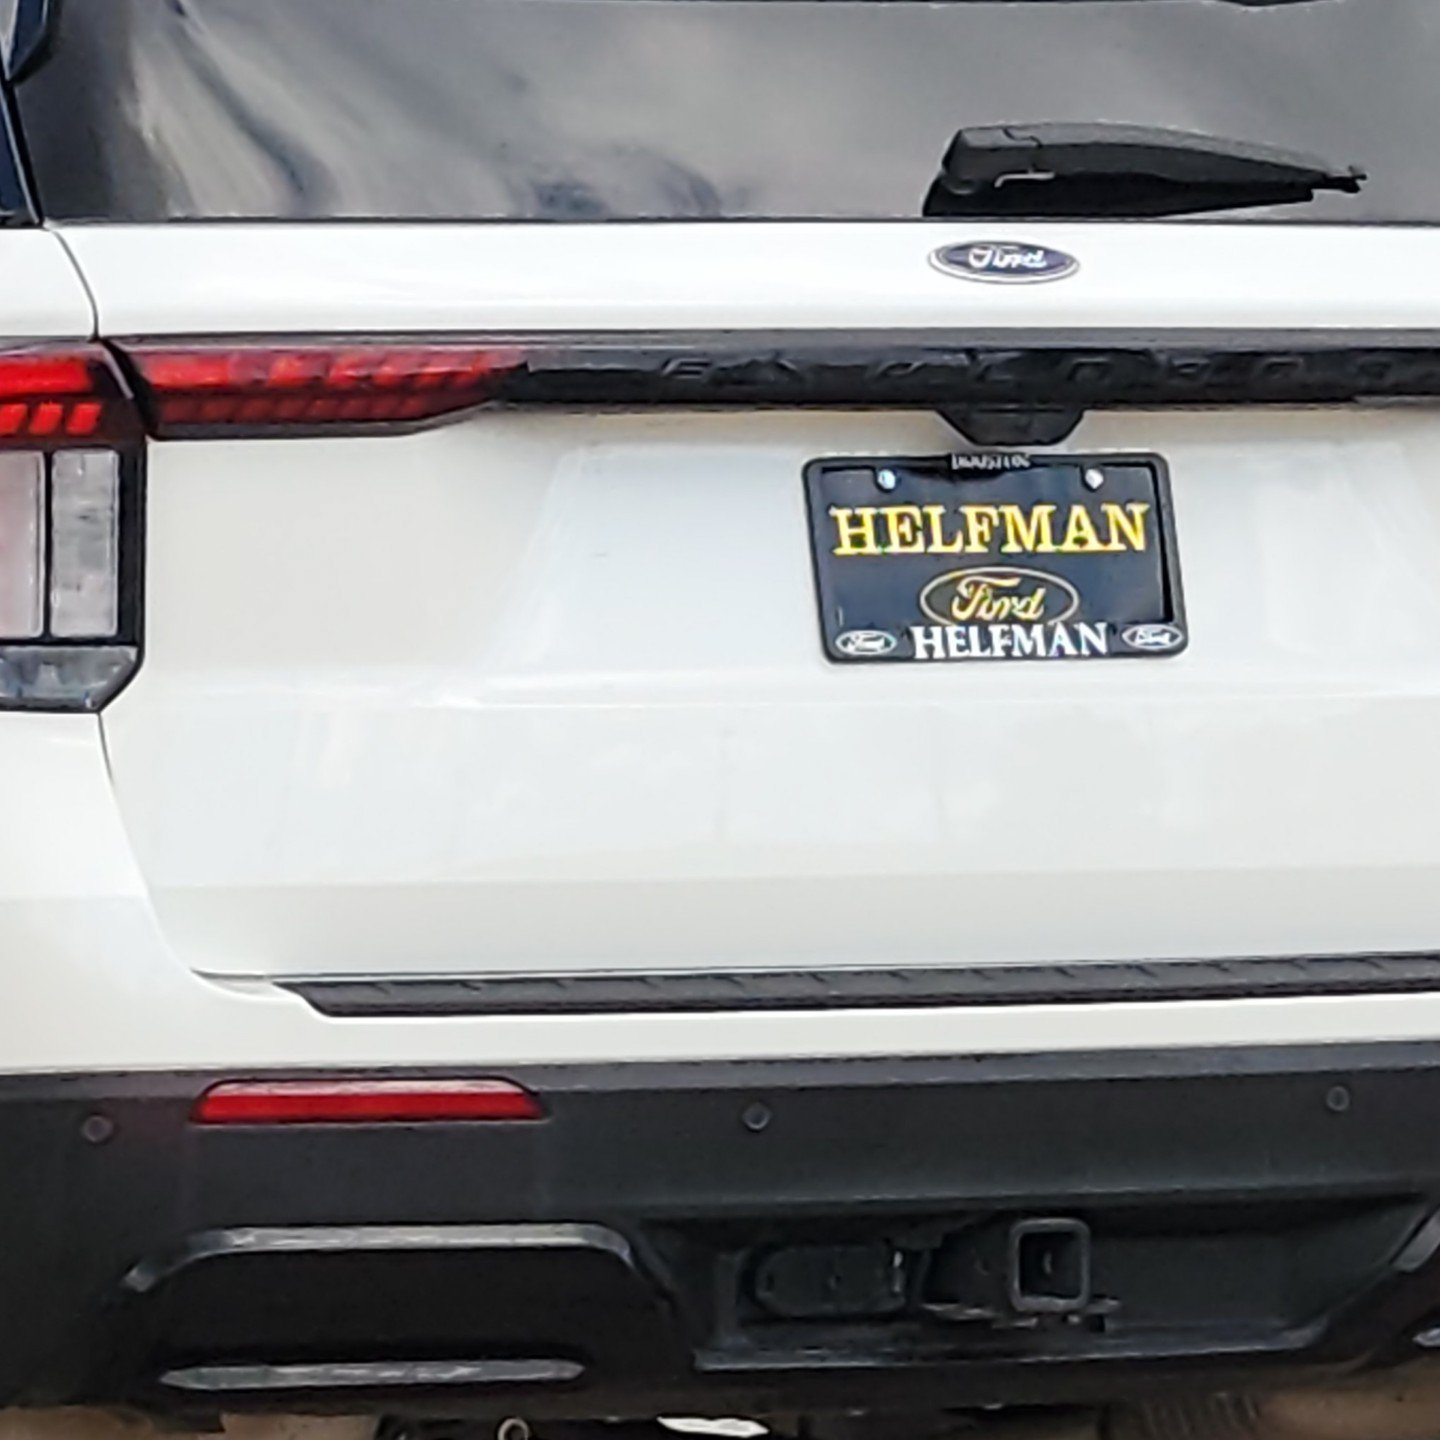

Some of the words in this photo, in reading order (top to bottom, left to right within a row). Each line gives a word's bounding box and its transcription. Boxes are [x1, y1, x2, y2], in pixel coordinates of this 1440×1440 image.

[967, 244, 1048, 270] Ford
[828, 501, 1152, 556] HELFMAN
[950, 574, 1048, 622] Ford
[908, 621, 1112, 660] HELFMAN
